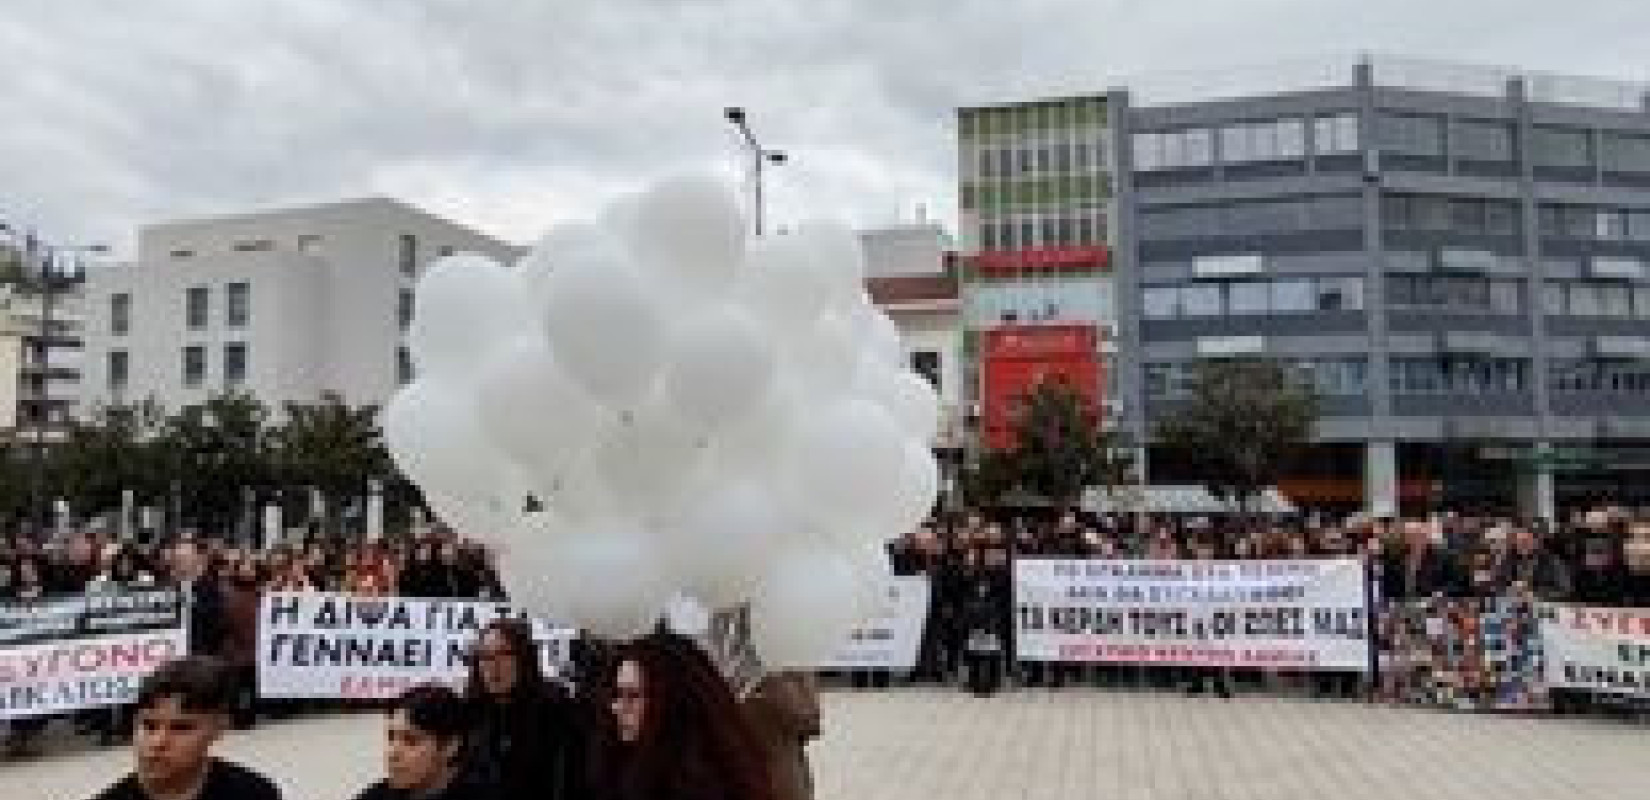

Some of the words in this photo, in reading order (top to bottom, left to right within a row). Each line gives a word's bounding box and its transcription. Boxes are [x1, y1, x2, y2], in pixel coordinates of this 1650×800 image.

[270, 597, 298, 624] Η
[313, 598, 410, 631] ΔΙΨΑ
[425, 602, 480, 631] ΓΙΑ
[270, 633, 433, 667] ΓΕΝΝΑΕΙ
